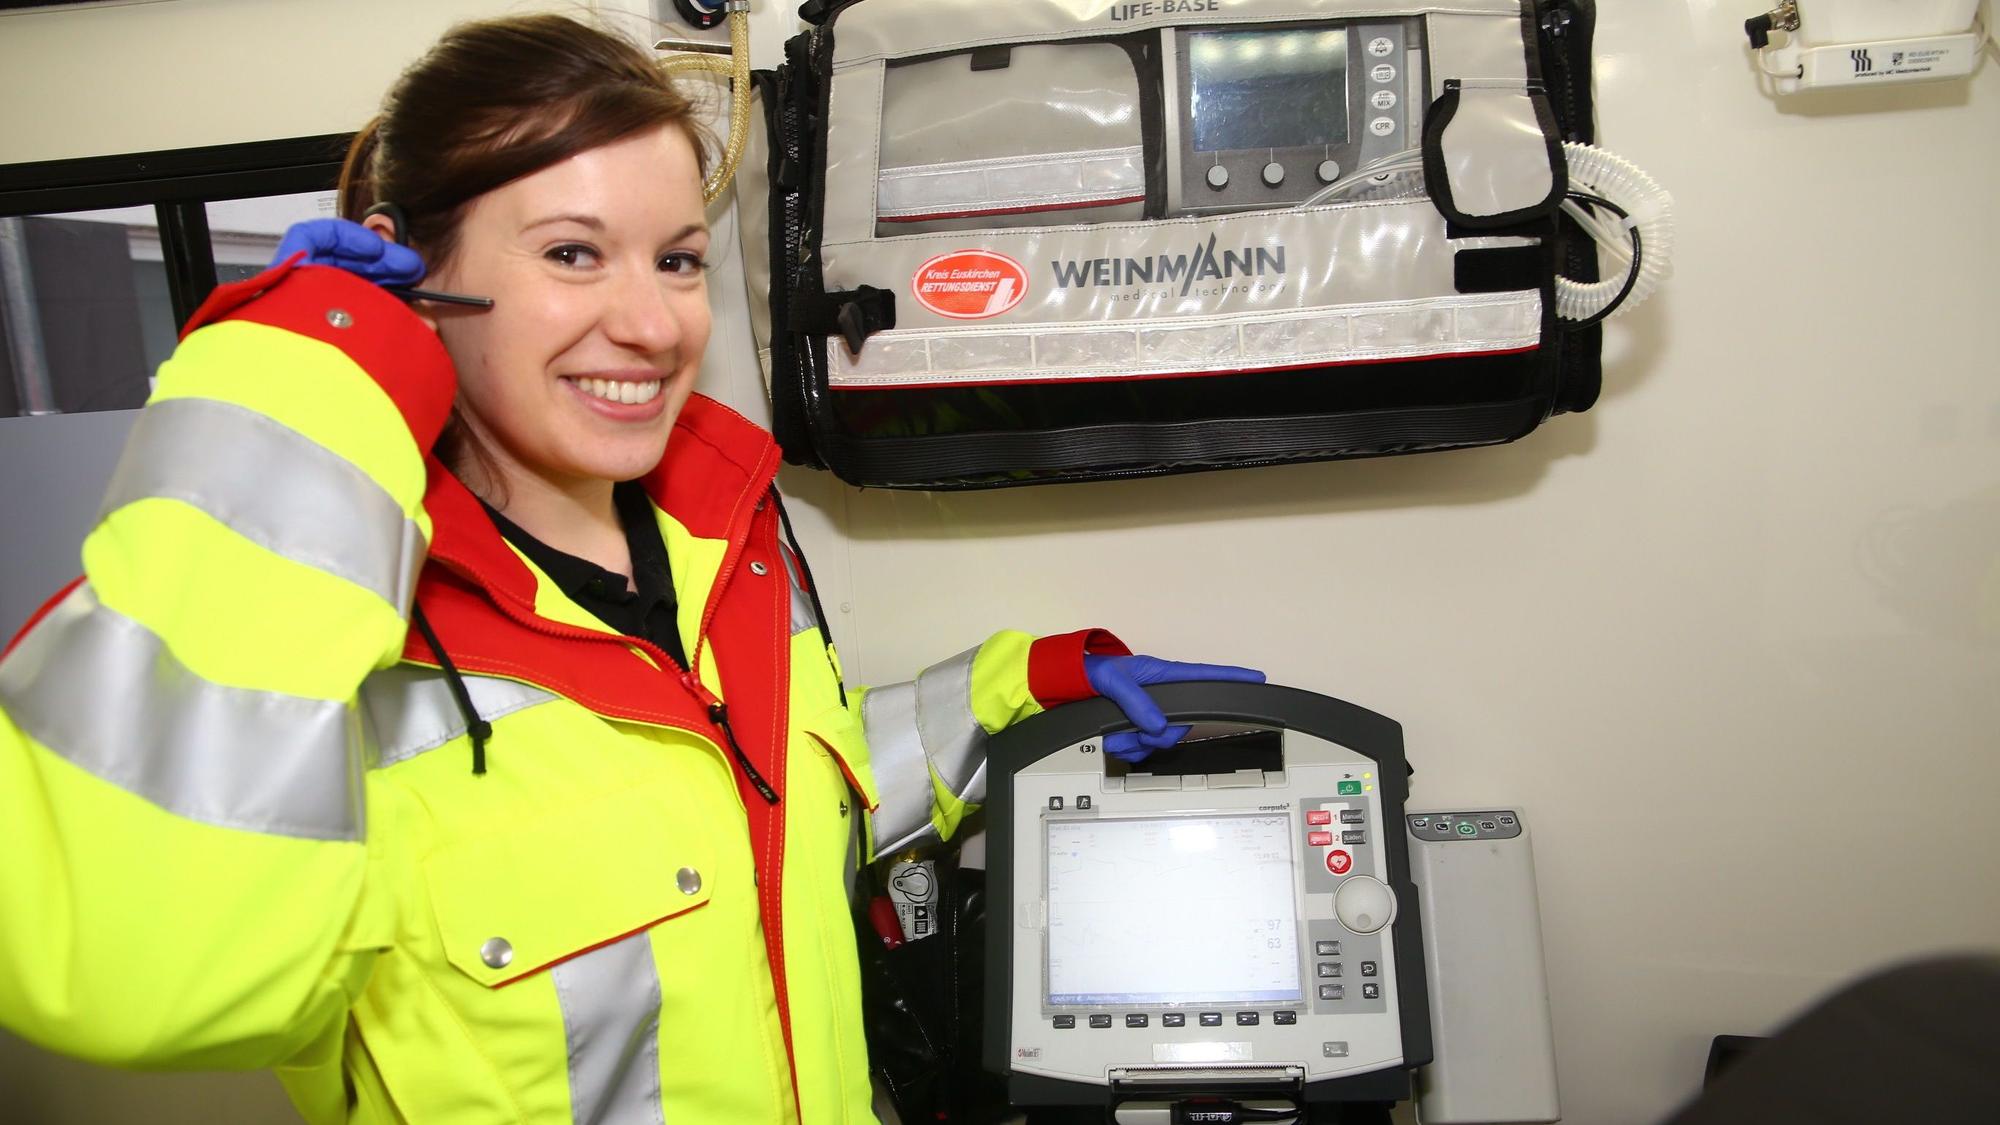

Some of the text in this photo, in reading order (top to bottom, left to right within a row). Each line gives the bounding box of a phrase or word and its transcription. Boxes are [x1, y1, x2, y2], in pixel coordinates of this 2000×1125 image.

[1110, 0, 1219, 21] LIFE-BASE
[1375, 122, 1390, 131] CPR
[1051, 231, 1286, 297] WEINMANN
[925, 268, 1001, 280] Kreis Euskirchen
[920, 281, 998, 293] RETTUNGSDIENST
[1110, 282, 1287, 301] medcal technoogy
